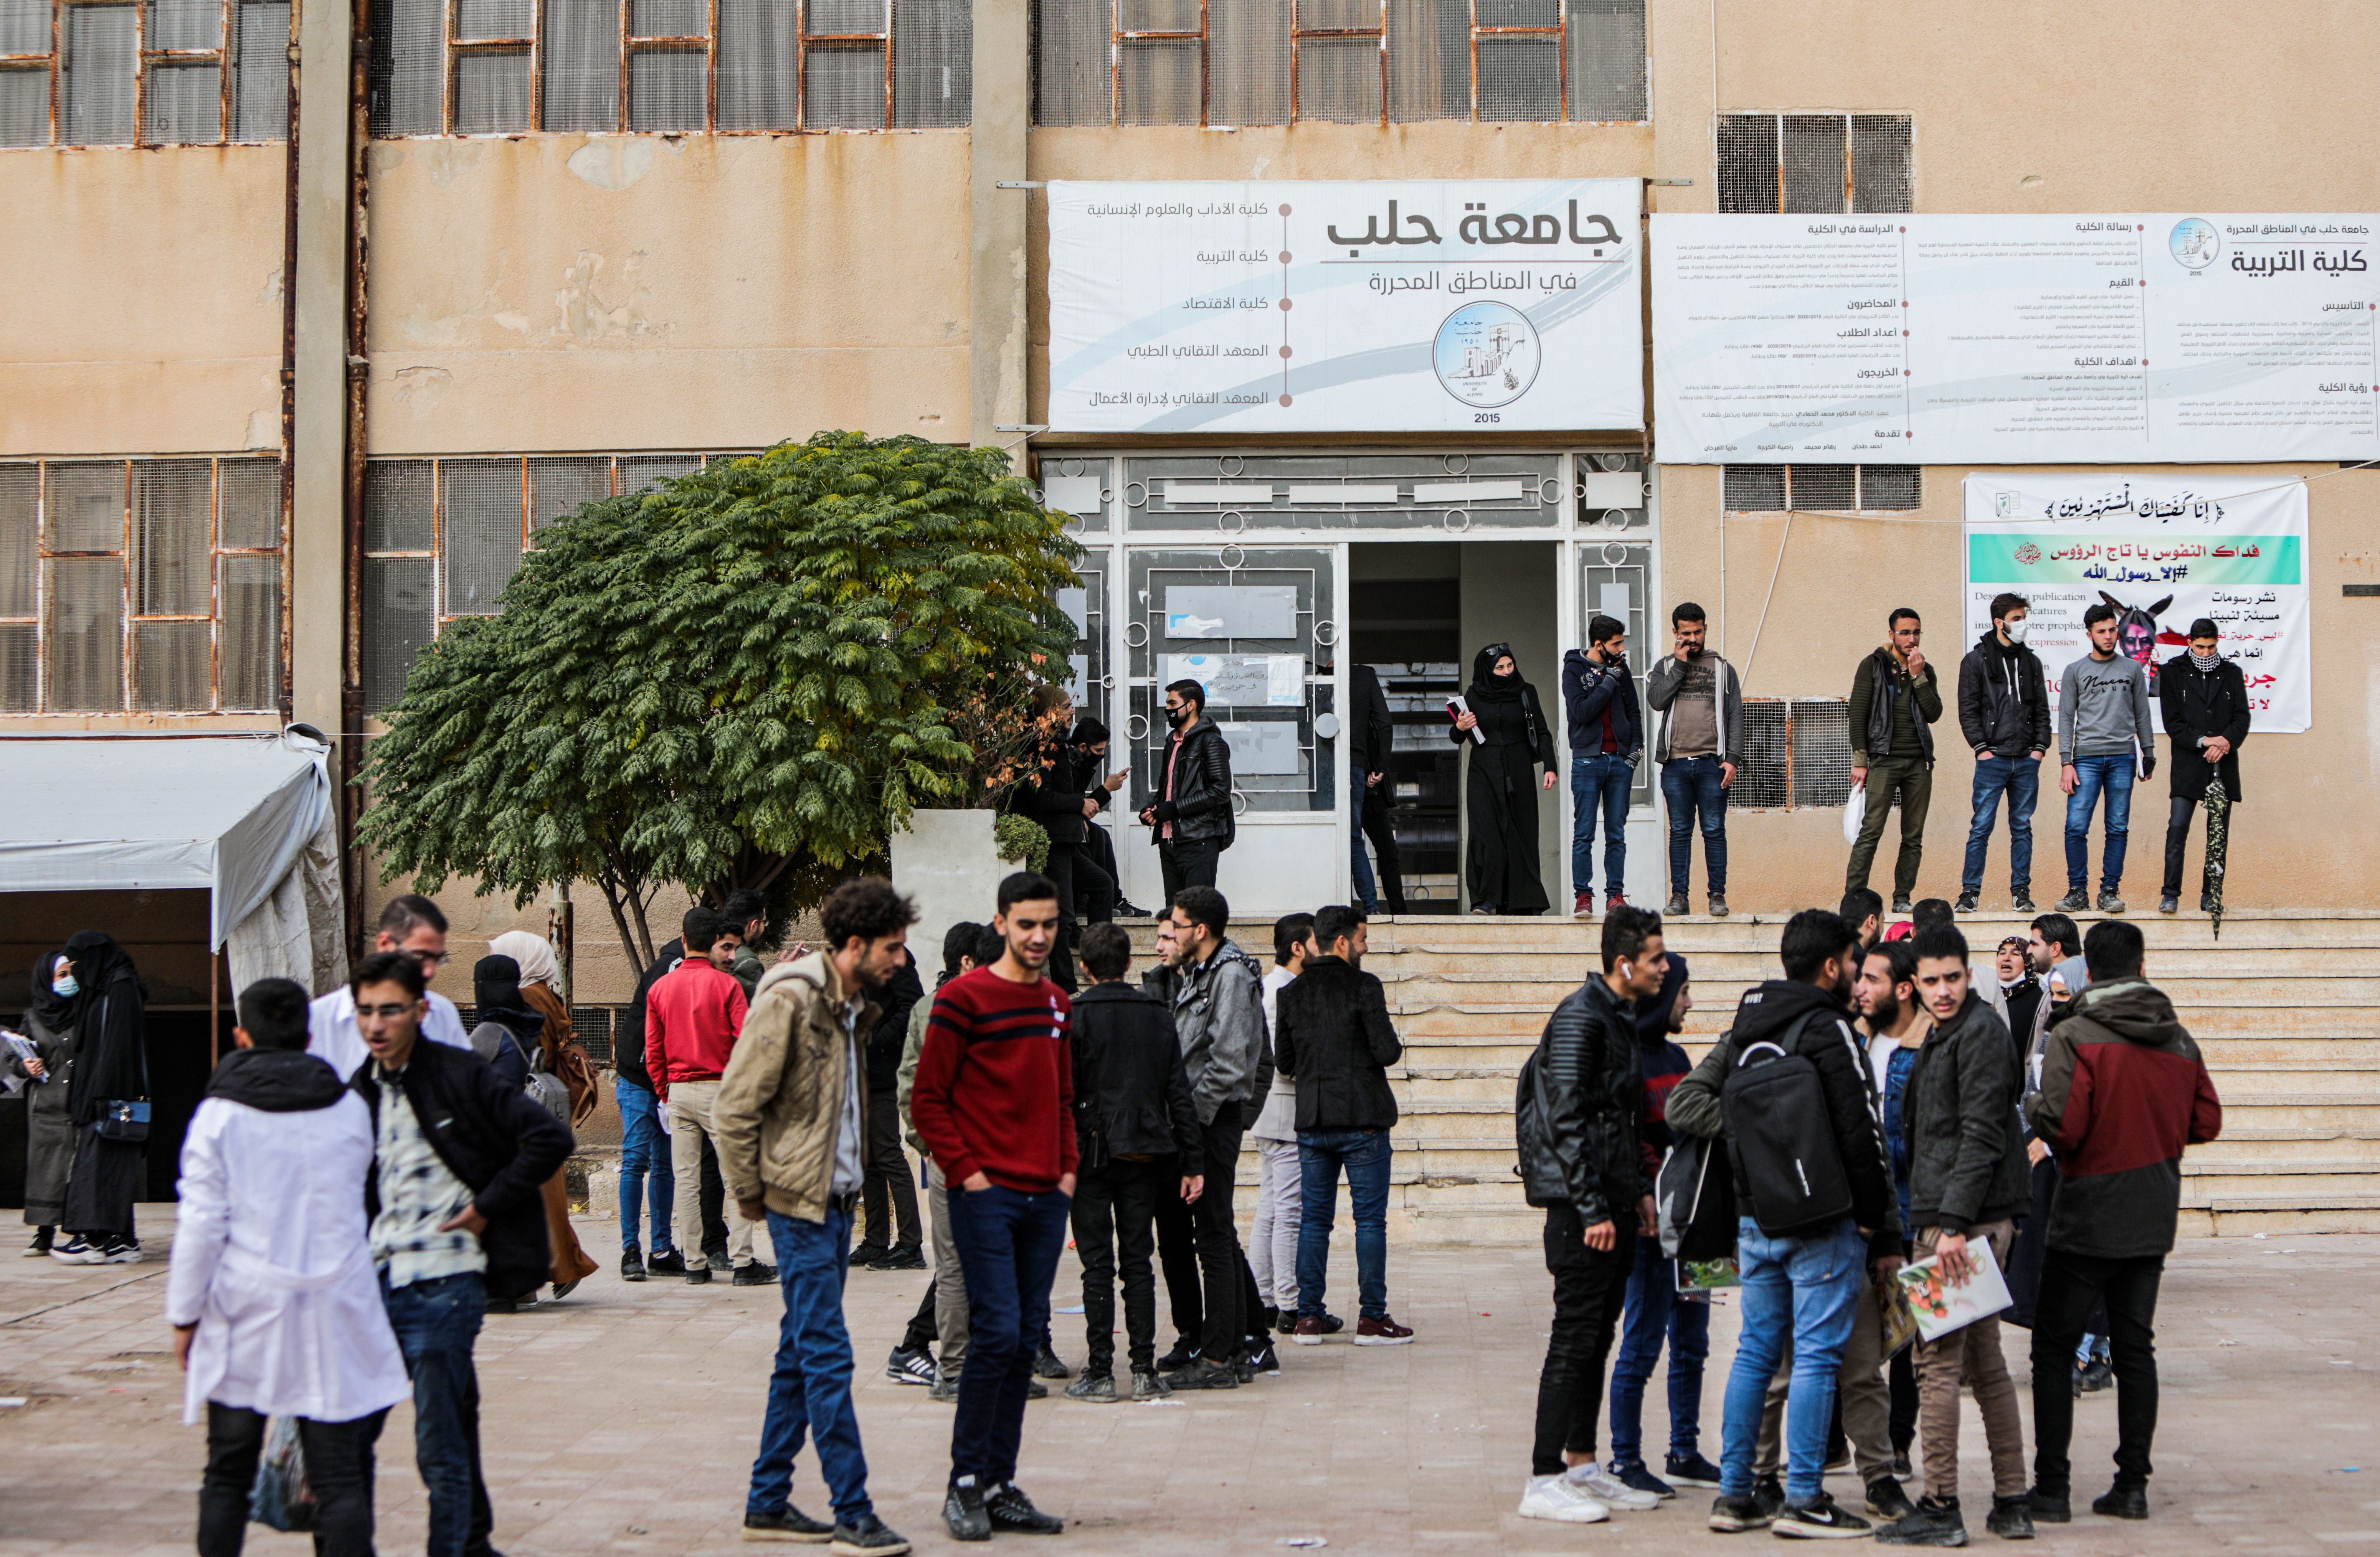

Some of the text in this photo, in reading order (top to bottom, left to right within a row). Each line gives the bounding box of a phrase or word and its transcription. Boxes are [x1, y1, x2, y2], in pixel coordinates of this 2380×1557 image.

[1145, 203, 1192, 218] والعلوم
[1239, 203, 1268, 217] كلية
[1327, 199, 1623, 257] جامعة حلب
[1808, 224, 1893, 235] الدراسة في الكلية
[2076, 222, 2132, 233] رسالة الكلية
[2226, 224, 2369, 236] جامعة حلب في المناطق المحررة
[1197, 250, 1268, 265] كلية التربية
[2231, 249, 2367, 277] كلية التربية
[1369, 270, 1576, 295] في المناطق المحررة
[2109, 278, 2133, 289] القيم
[1183, 297, 1268, 312] كلية الاقتصاد
[1847, 299, 1896, 310] المحاضرون
[2322, 300, 2363, 312] التأسيس
[1837, 327, 1897, 339] أعداد الطلاب
[1128, 344, 1268, 359] المعهد التقاني الطبي
[2074, 356, 2136, 368] أهداف الكلية
[1857, 367, 1898, 379] الخريجون
[2319, 383, 2367, 394] رؤية الكلية
[1089, 392, 1131, 406] الأعمال
[1173, 392, 1218, 407] التقاني
[1223, 392, 1268, 404] المعهد
[1475, 413, 1500, 423] 2015
[2050, 543, 2102, 561] الرؤوس
[2106, 544, 2132, 562] تاج
[2137, 544, 2149, 561] يا
[2152, 543, 2207, 561] النفوس
[2211, 544, 2260, 557] فداك
[2033, 592, 2086, 602] publication
[2212, 592, 2276, 605] نشر رسومات
[2210, 610, 2280, 623] مسيئة لنبينا
[2048, 621, 2086, 632] prophèt
[2029, 638, 2078, 647] expression
[2223, 648, 2263, 661] إنما هي
[2091, 686, 2127, 694] CLUB
[2259, 699, 2270, 709] لا
